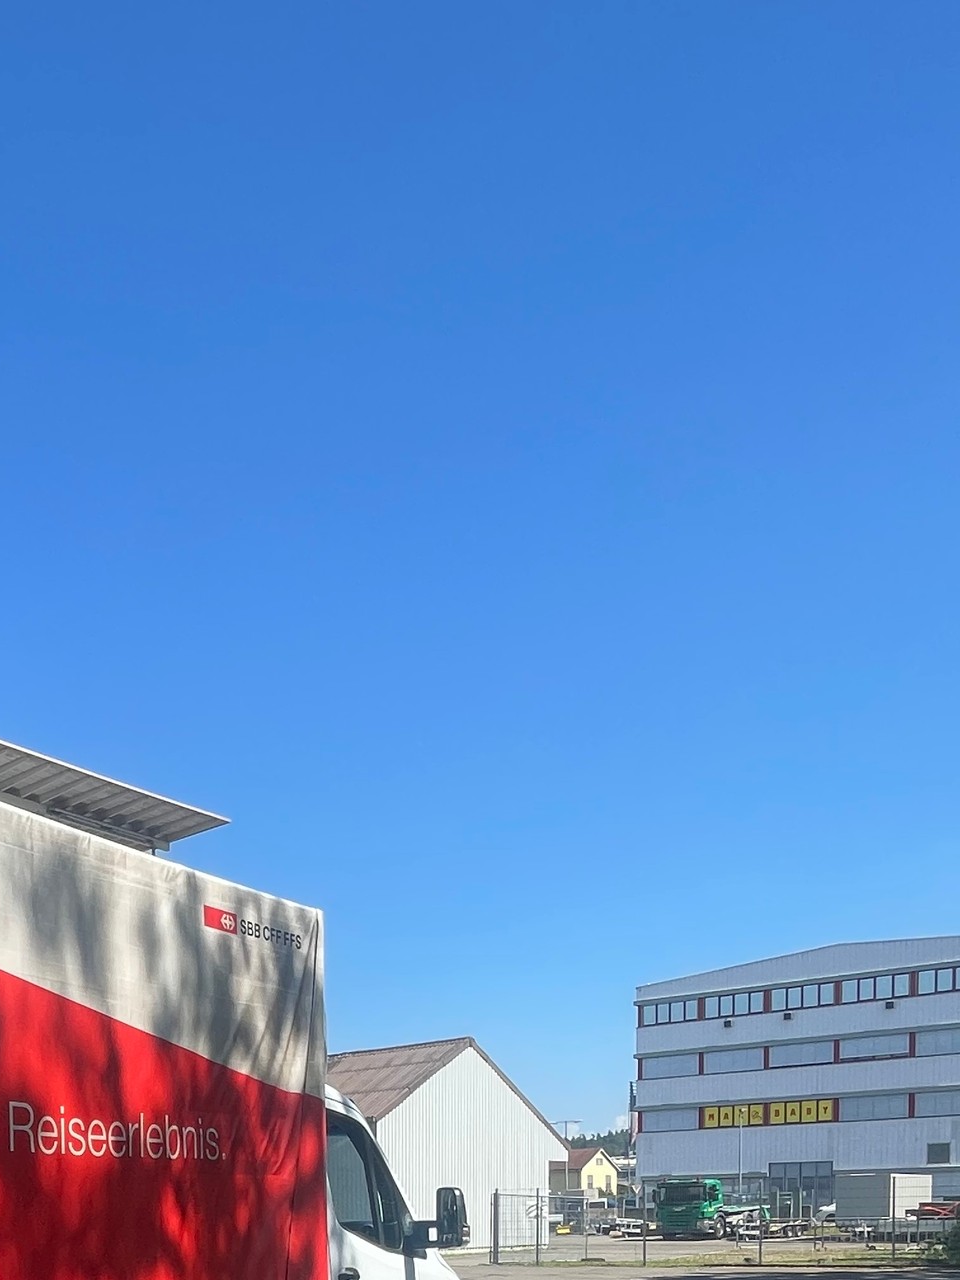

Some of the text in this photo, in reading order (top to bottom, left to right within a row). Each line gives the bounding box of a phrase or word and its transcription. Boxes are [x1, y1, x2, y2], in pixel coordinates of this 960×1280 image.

[240, 918, 302, 950] SBB CFF FFS
[774, 1106, 829, 1118] BABY
[7, 1100, 228, 1162] Reiseerlebnis.
